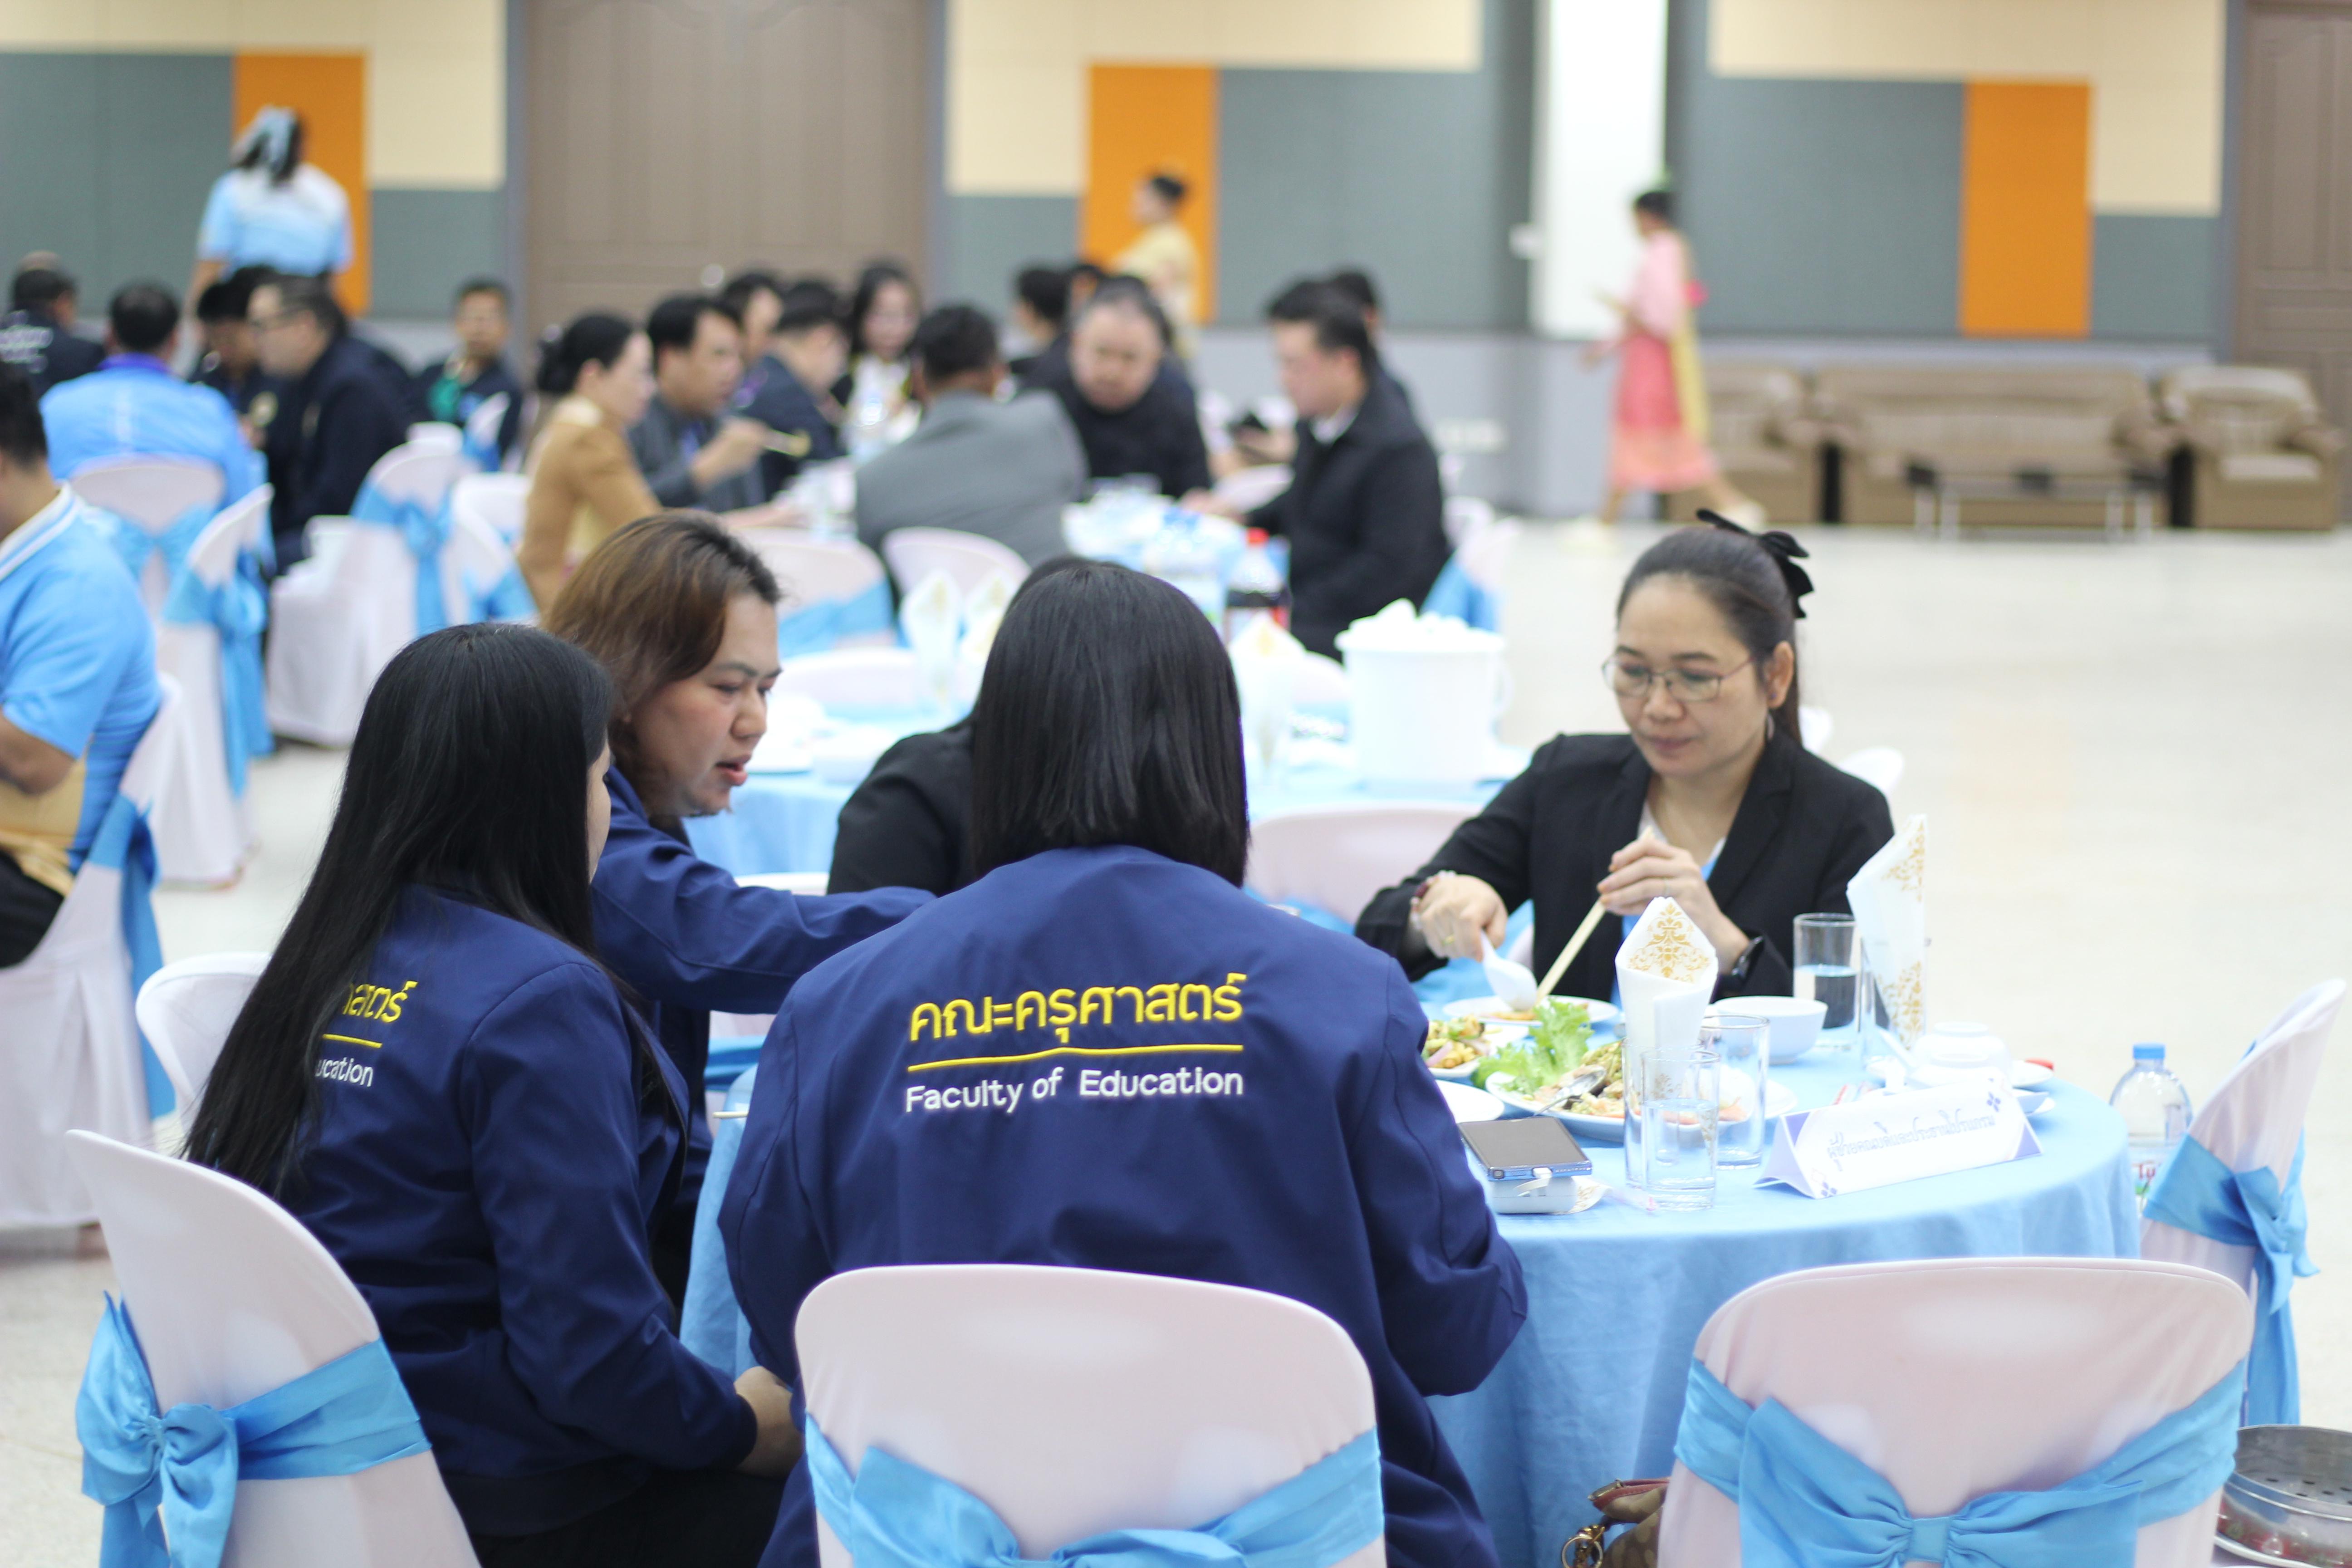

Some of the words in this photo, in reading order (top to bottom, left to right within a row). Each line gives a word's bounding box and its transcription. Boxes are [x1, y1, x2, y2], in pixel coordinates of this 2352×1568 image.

[909, 972, 1247, 1044] คณะครุศาสตร์
[315, 1057, 374, 1087] ucation
[906, 1080, 1024, 1113] Faculty
[1032, 1066, 1064, 1099] of
[1079, 1066, 1244, 1097] Education
